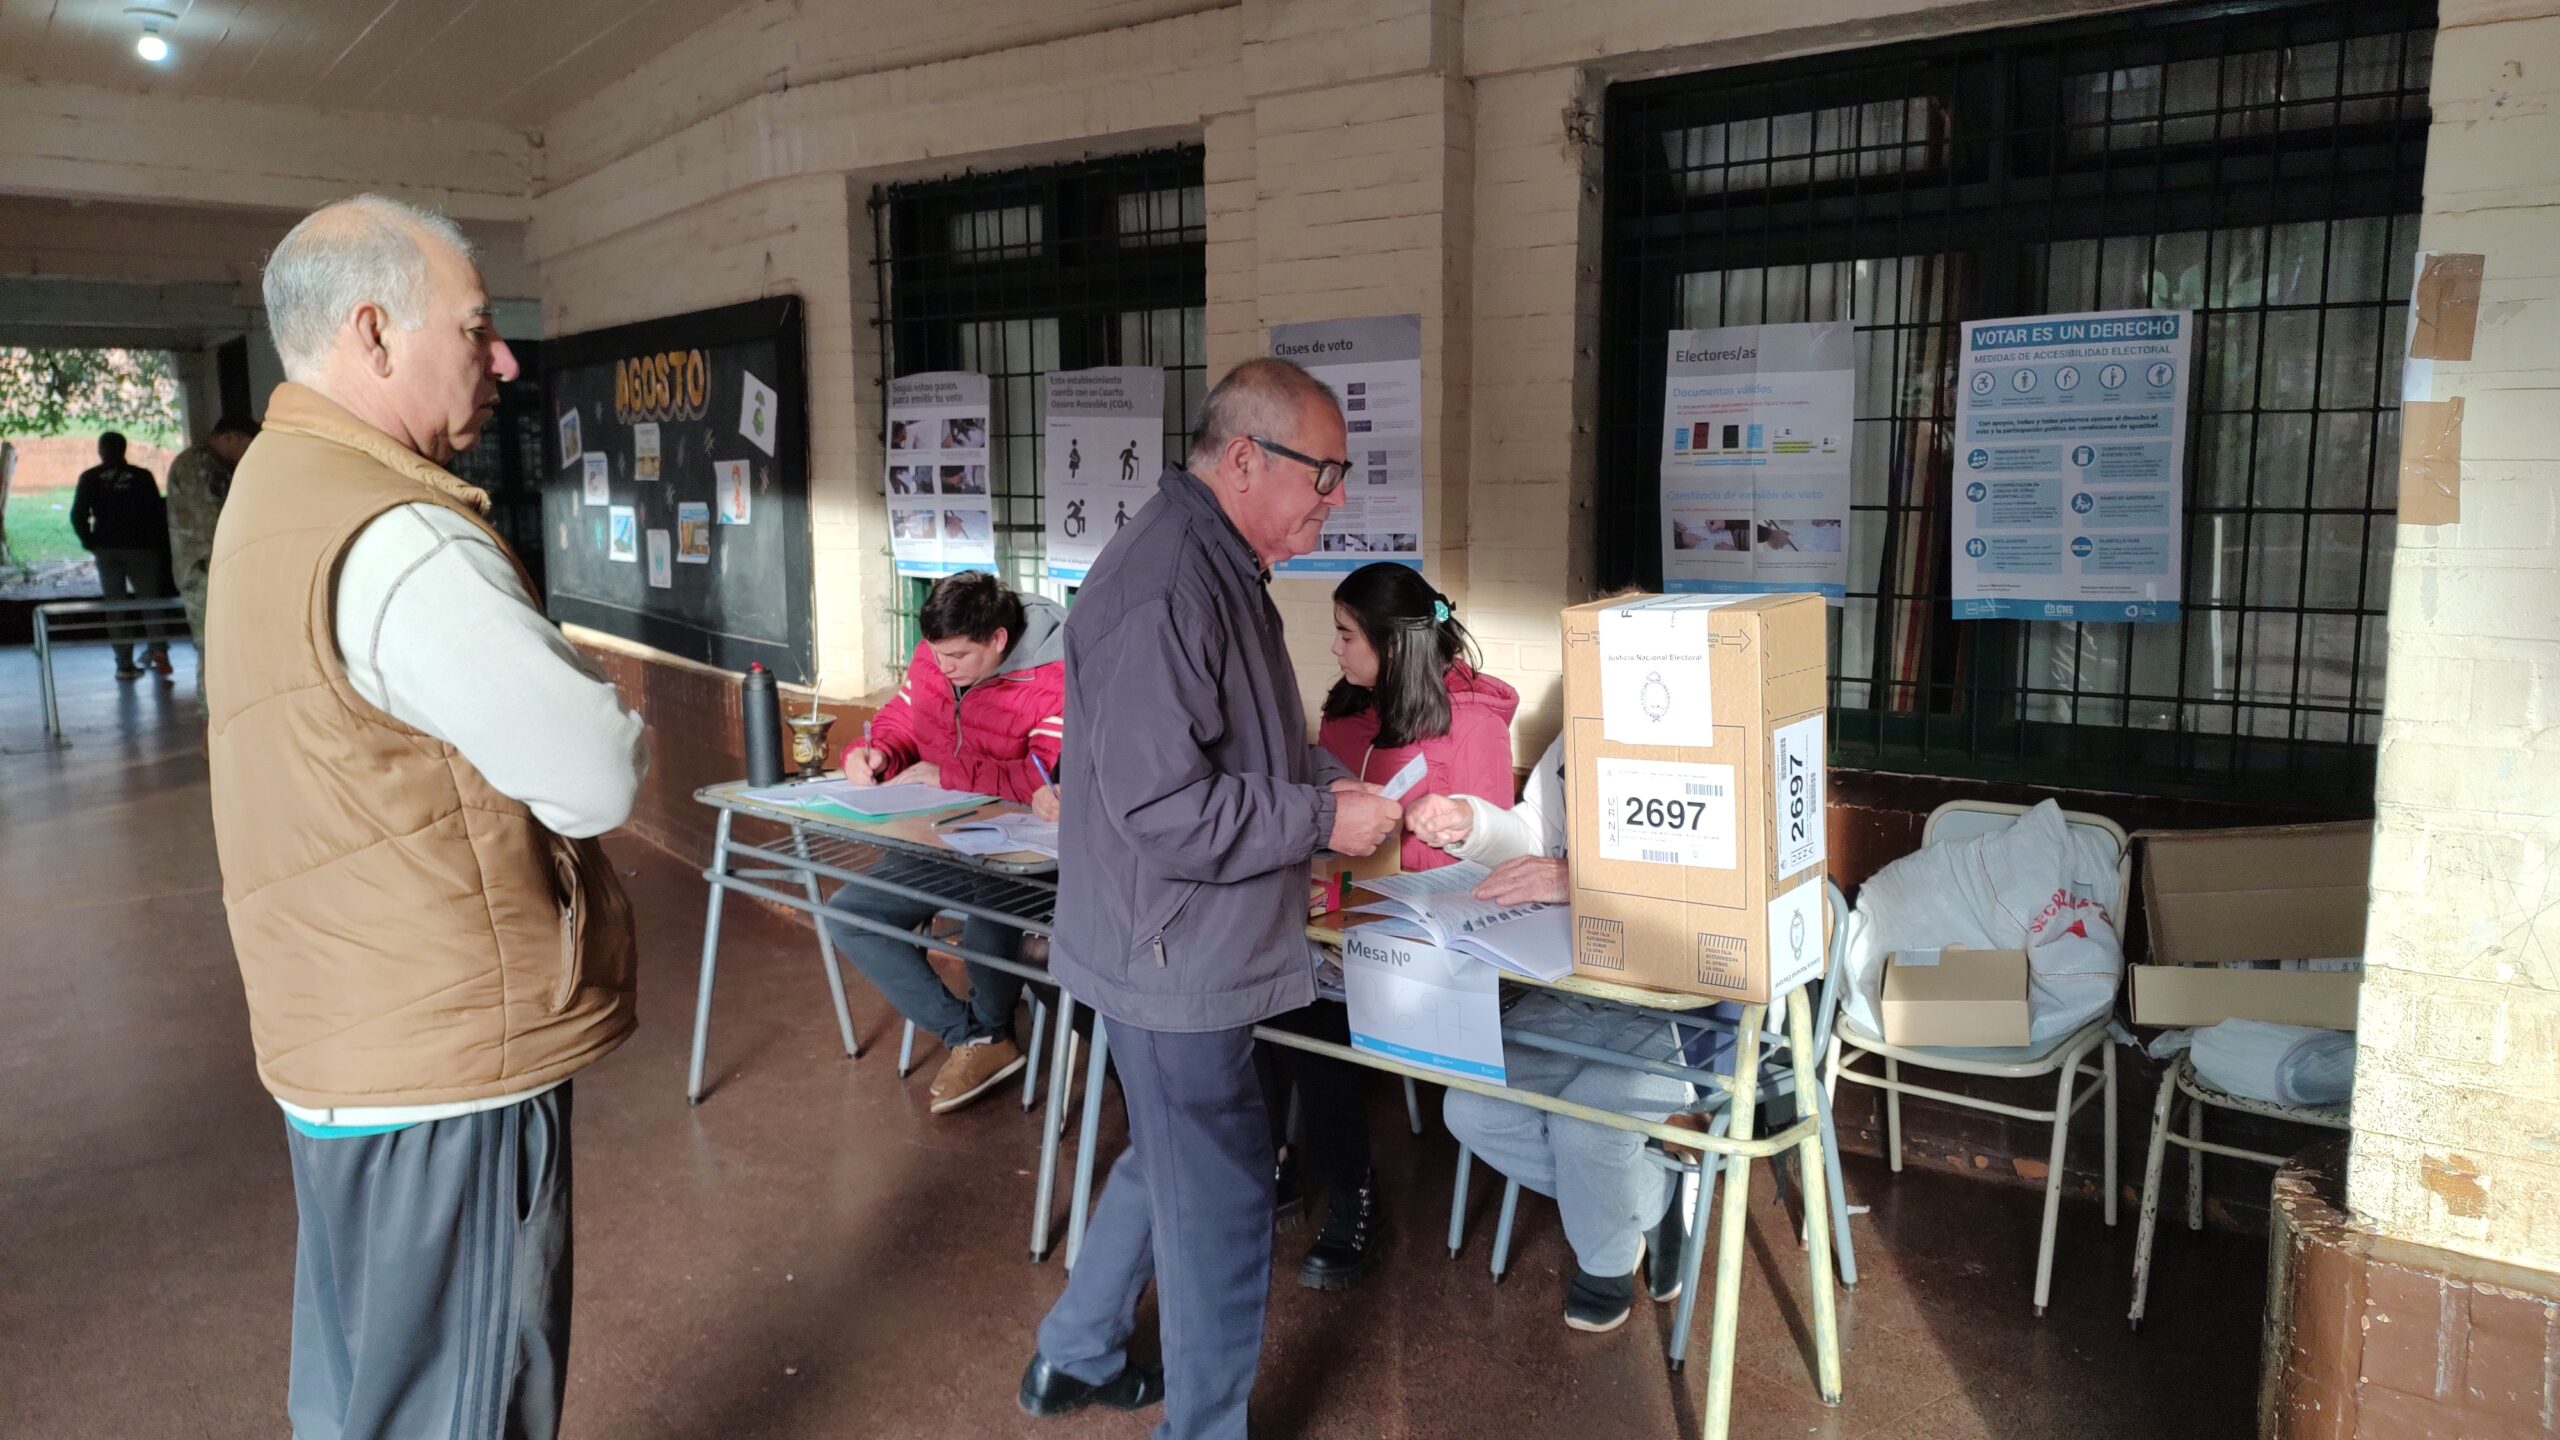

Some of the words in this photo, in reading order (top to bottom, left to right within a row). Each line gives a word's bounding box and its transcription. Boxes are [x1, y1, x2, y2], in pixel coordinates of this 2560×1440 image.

[1975, 329, 2028, 346] VOTAR
[2031, 328, 2053, 342] ES
[2060, 325, 2085, 340] UN
[2090, 320, 2175, 338] DERECHO
[1275, 341, 1310, 356] Clases
[1312, 340, 1326, 354] de
[1328, 338, 1353, 352] voto
[1676, 346, 1757, 363] Electores/as
[1974, 352, 2016, 364] MEDIDAS
[2018, 351, 2031, 361] DE
[2033, 347, 2108, 360] ACCESIBILIDAD
[2111, 345, 2172, 355] ELECTORAL
[616, 349, 710, 420] AGOSTO
[934, 382, 958, 394] pasos
[1099, 388, 1124, 397] Cuarto
[1673, 385, 1735, 398] Documentos
[1736, 383, 1773, 396] válidos
[892, 396, 909, 406] para
[945, 393, 963, 402] voto
[1666, 490, 1721, 500] Constancia
[1723, 489, 1735, 500] de
[1738, 489, 1777, 500] emisión
[1781, 489, 1793, 500] de
[1798, 490, 1824, 499] voto
[1669, 653, 1702, 661] Electoral
[1790, 754, 1804, 843] 2697
[1626, 796, 1706, 831] 2697
[1347, 939, 1388, 964] Mesa
[1391, 949, 1411, 967] Nº
[1361, 975, 1472, 1047] 2697
